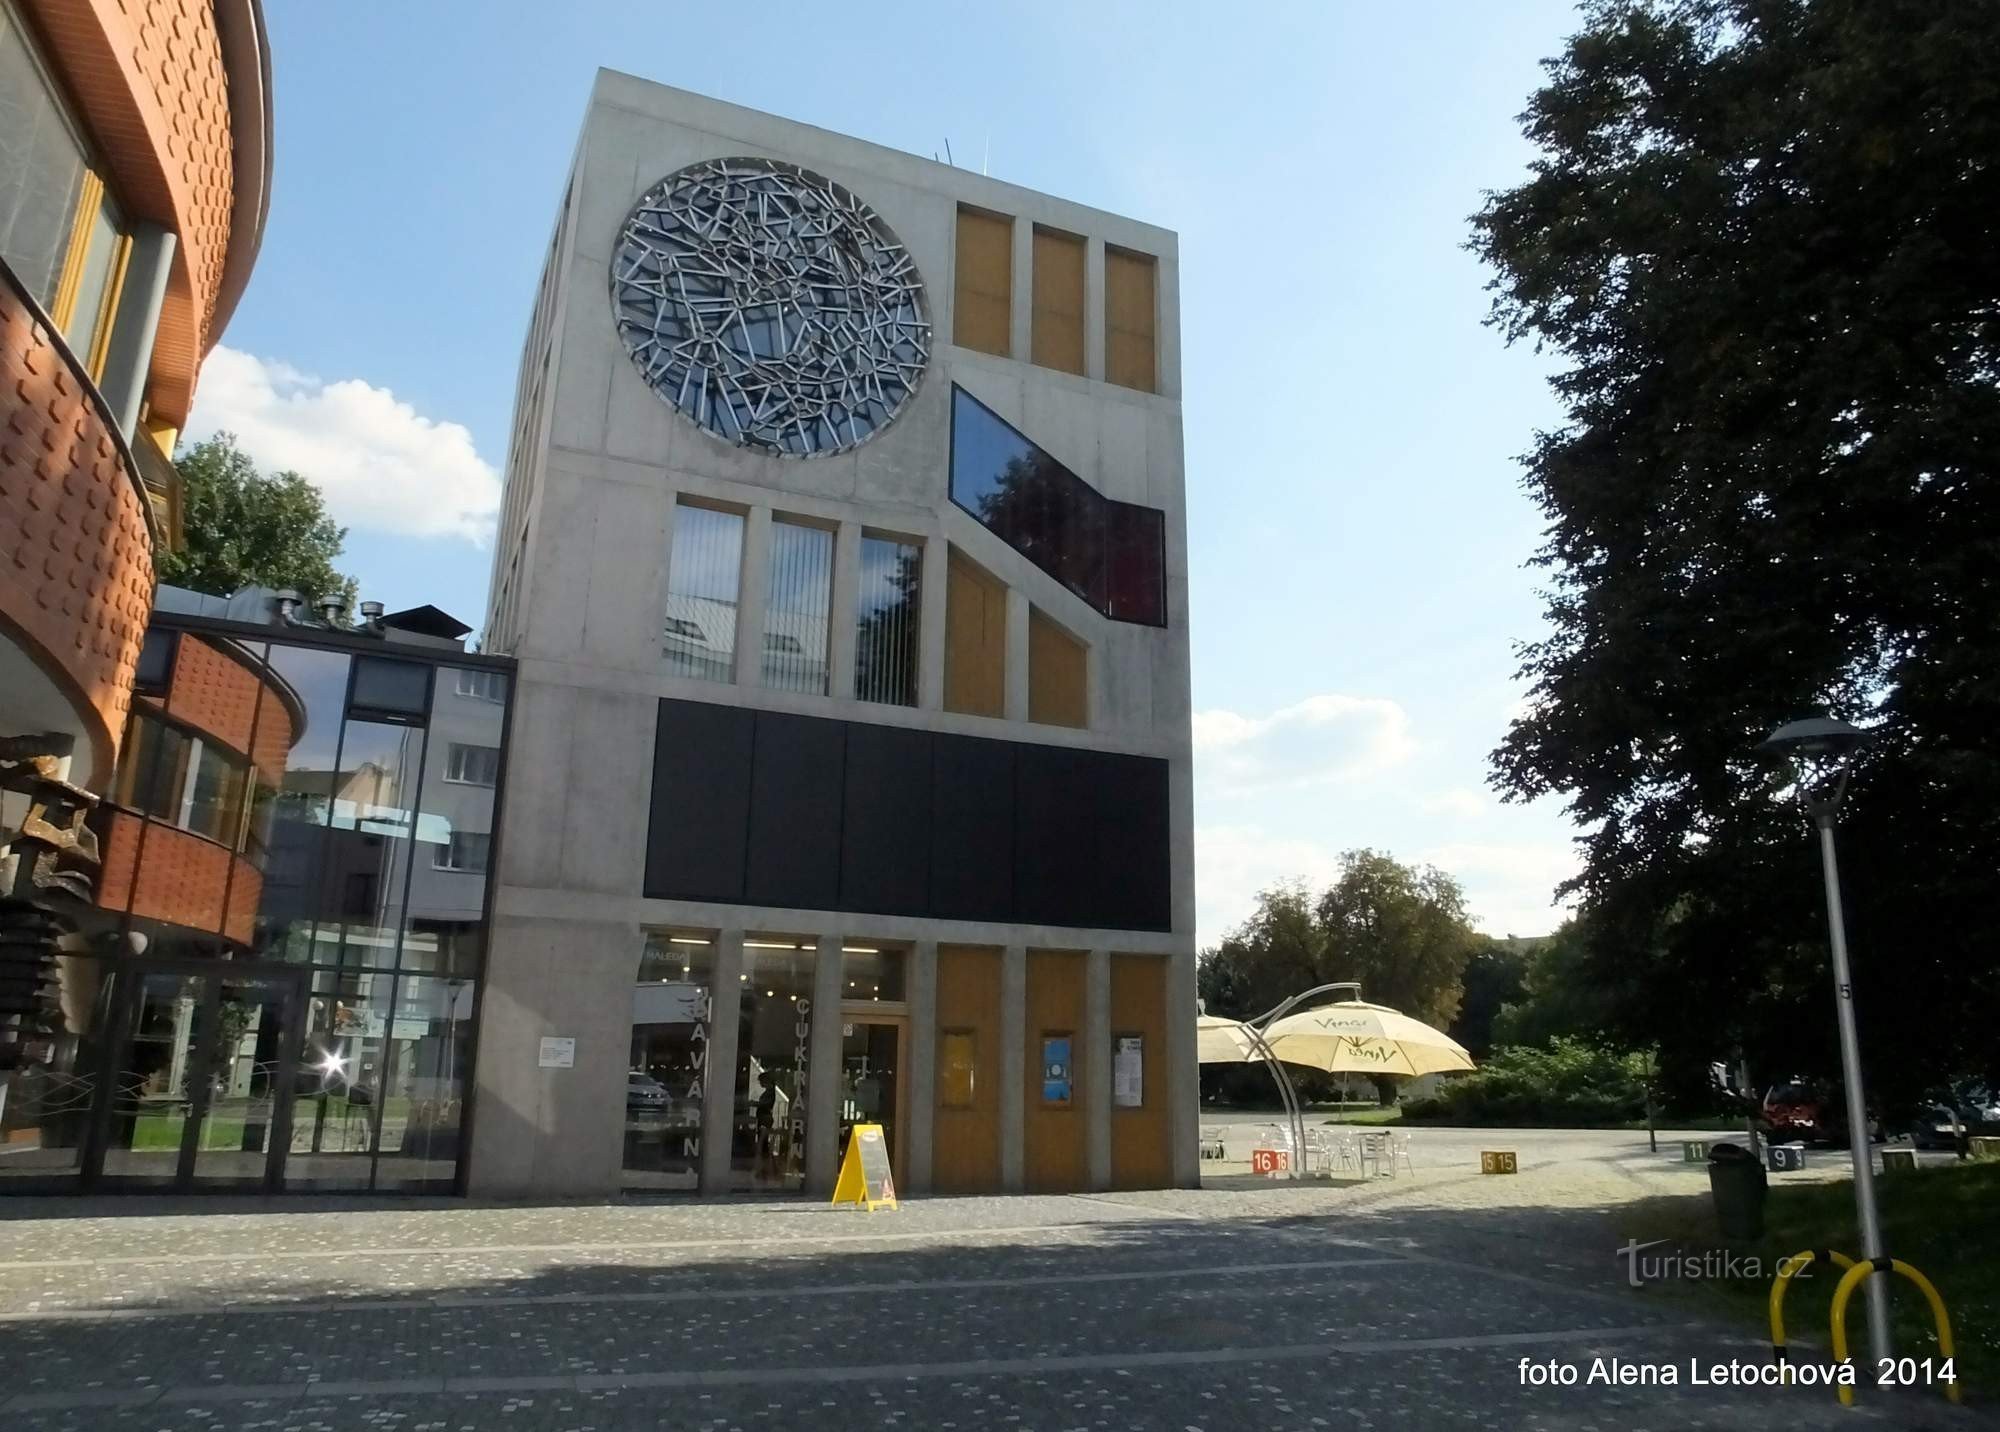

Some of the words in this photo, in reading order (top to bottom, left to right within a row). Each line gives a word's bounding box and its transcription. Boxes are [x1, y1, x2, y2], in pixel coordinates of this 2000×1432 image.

[682, 995, 708, 1186] AVÁRN
[1254, 1153, 1271, 1170] 16
[1276, 1152, 1287, 1170] 16
[1483, 1154, 1494, 1170] 15
[1497, 1154, 1513, 1171] 15
[1774, 1149, 1786, 1168] 9
